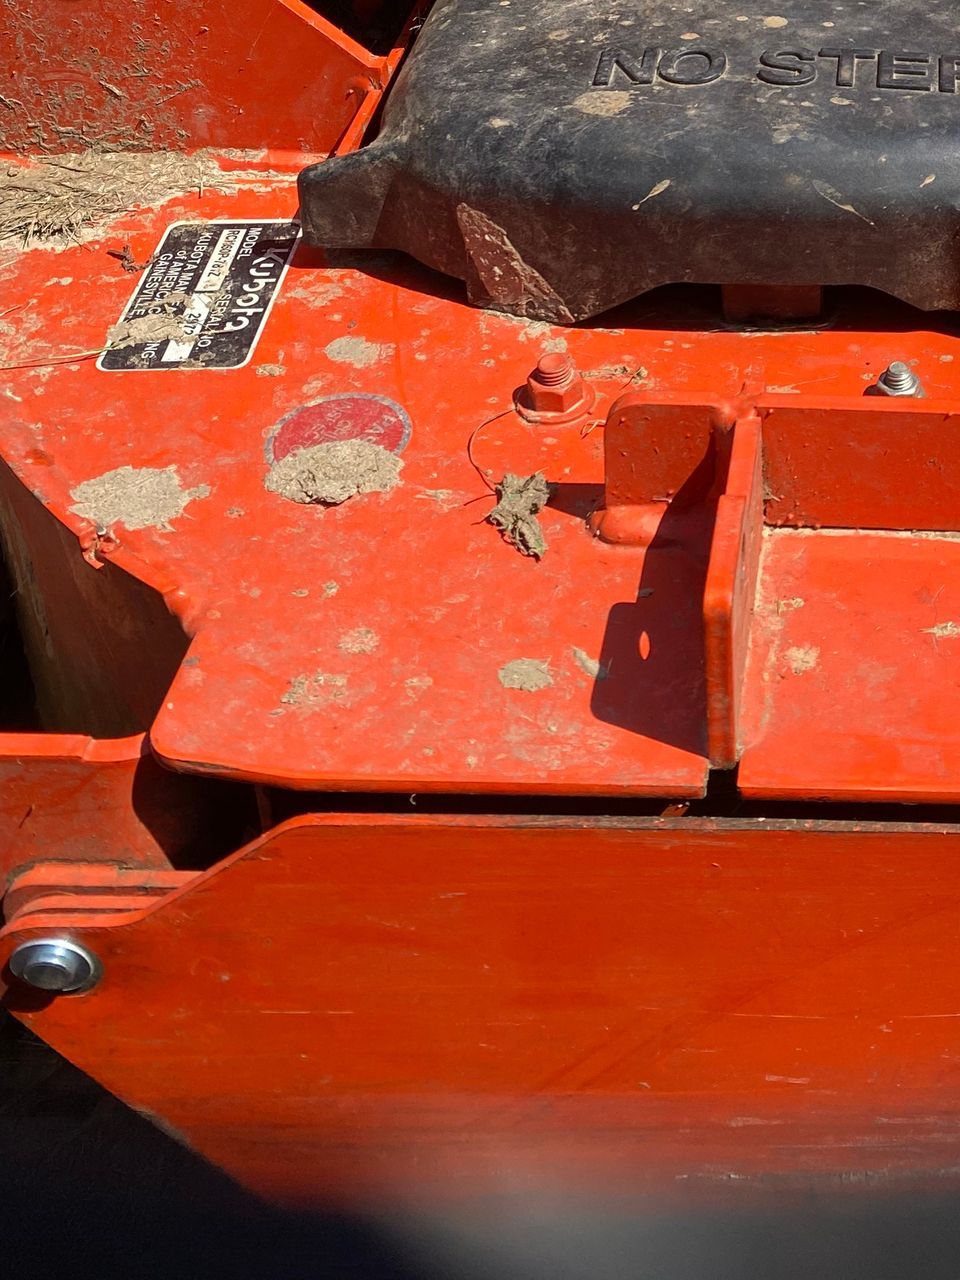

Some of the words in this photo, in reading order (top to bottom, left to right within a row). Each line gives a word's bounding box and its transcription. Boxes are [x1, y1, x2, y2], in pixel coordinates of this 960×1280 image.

[591, 48, 728, 86] NO
[176, 250, 190, 260] of
[183, 232, 214, 271] KUBOTA
[236, 227, 263, 260] MODEL
[225, 248, 289, 332] Kubota
[205, 294, 232, 330] SERIAL
